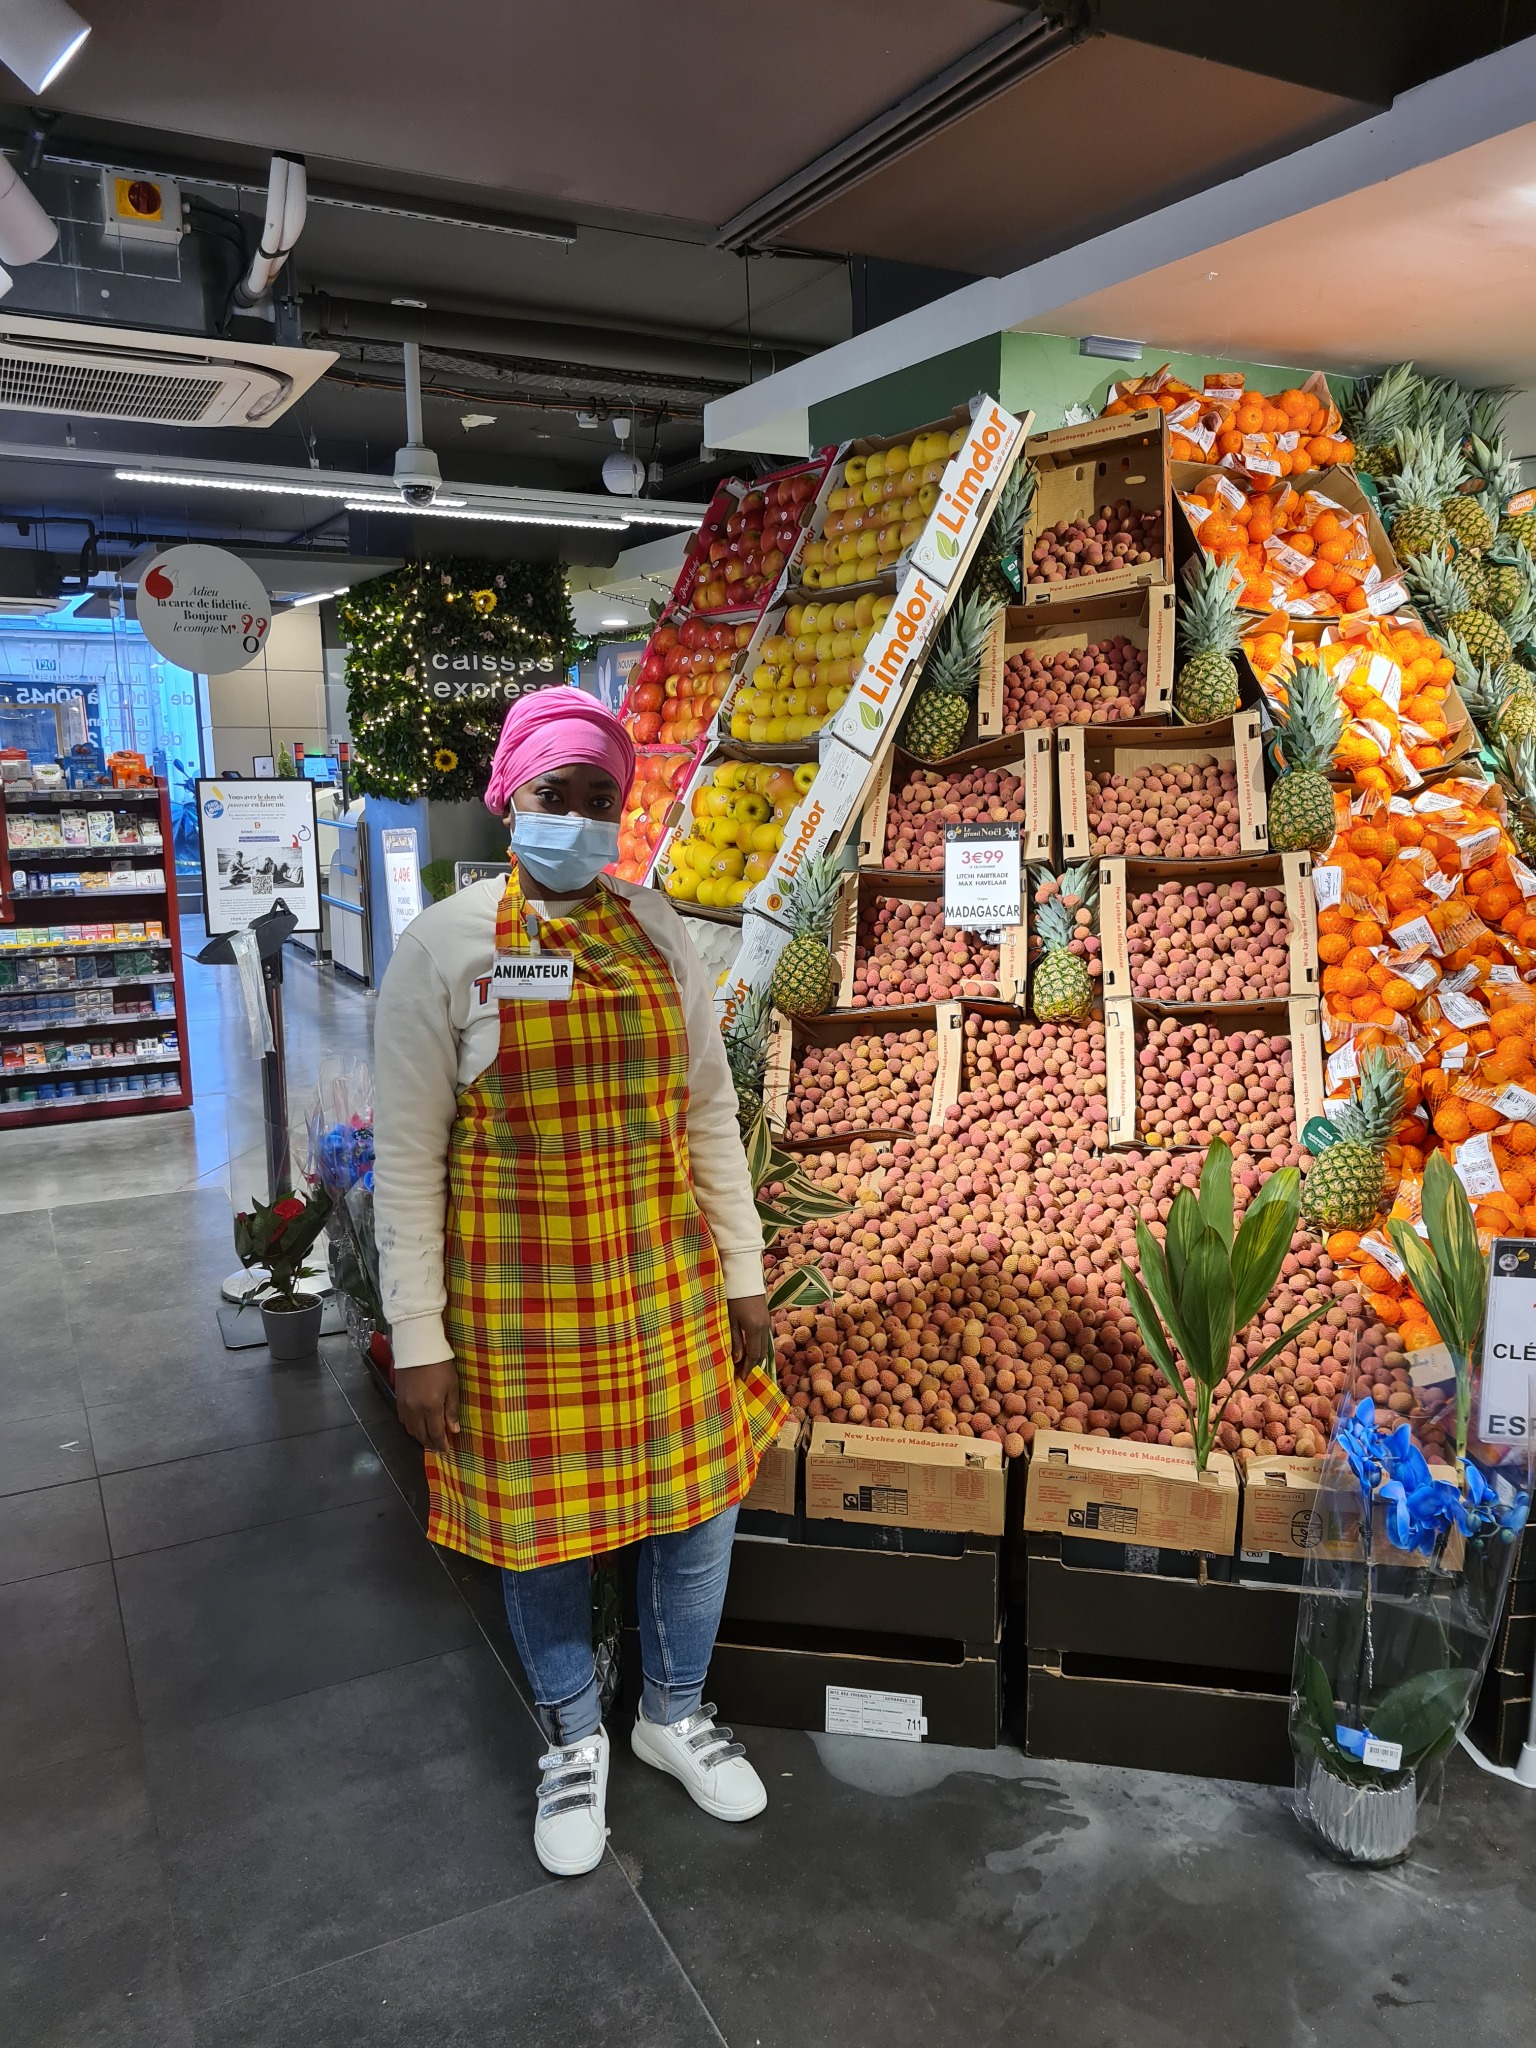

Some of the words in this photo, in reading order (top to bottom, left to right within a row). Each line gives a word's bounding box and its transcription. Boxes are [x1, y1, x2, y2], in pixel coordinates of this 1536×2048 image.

[937, 407, 1007, 534] Limdor
[189, 586, 219, 597] Adieu
[1049, 584, 1063, 593] New
[168, 599, 195, 608] carte
[197, 598, 210, 609] de
[211, 599, 251, 610] fidélité.
[184, 610, 228, 623] Bonjour
[173, 622, 182, 632] le
[183, 624, 219, 635] compte
[860, 578, 932, 705] Limdor
[432, 651, 554, 673] caisses
[724, 672, 748, 712] Limdor
[778, 800, 826, 878] Limdor
[963, 830, 981, 838] grand
[981, 826, 1001, 837] Noël
[961, 850, 1004, 864] 3€99
[393, 866, 411, 885] 2,49€
[945, 904, 1021, 918] MADAGASCAR
[494, 964, 569, 979] ANIMATEUR
[1299, 1033, 1307, 1072] Madagascar
[1302, 1083, 1310, 1105] Lychee
[1488, 1414, 1536, 1436] ES
[844, 1431, 863, 1440] New
[865, 1433, 896, 1444] Lychee
[908, 1437, 959, 1448] Madagascar
[1073, 1443, 1094, 1452] New
[1096, 1446, 1127, 1457] Lychee
[1129, 1451, 1140, 1459] of
[1141, 1453, 1196, 1466] Madagascar
[1289, 1464, 1310, 1472] New
[907, 1718, 921, 1731] 711
